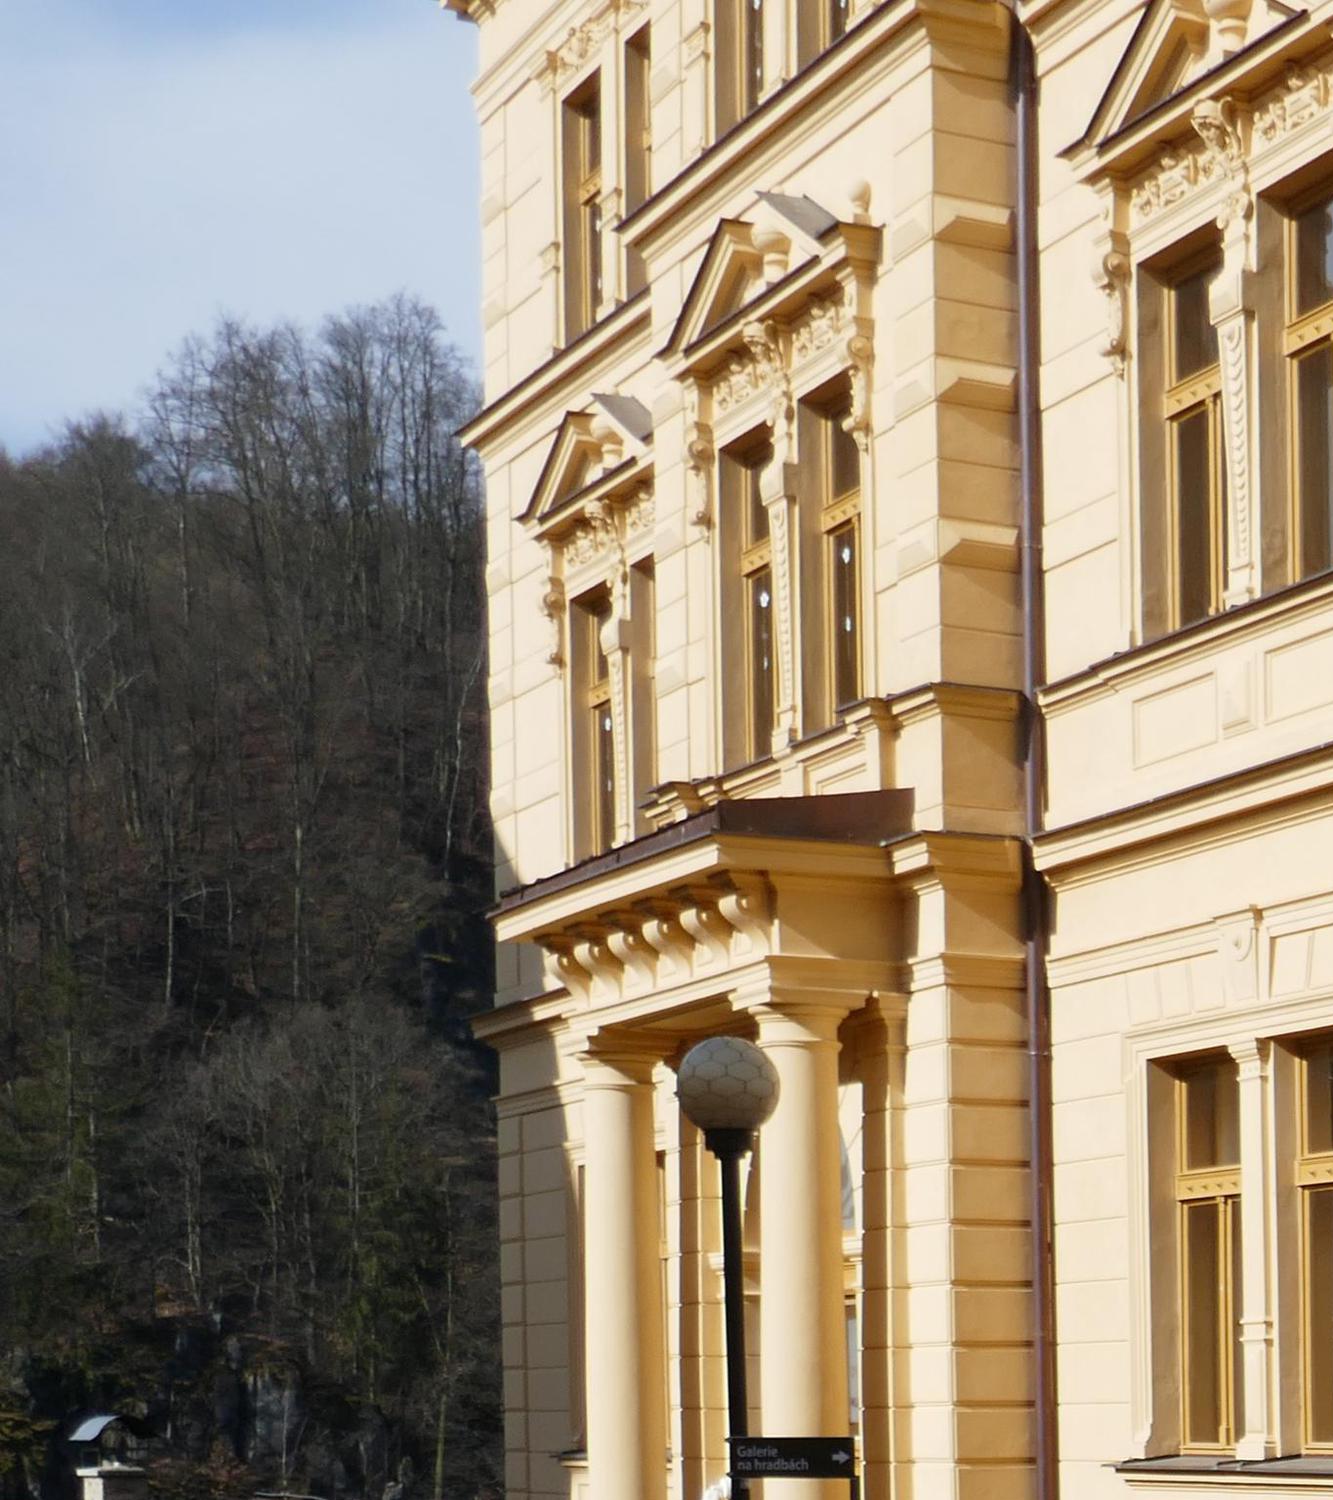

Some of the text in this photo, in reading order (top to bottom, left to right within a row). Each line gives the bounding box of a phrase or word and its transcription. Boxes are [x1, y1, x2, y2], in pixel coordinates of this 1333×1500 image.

[737, 1445, 778, 1458] Galerie
[738, 1458, 808, 1471] na hradbách
